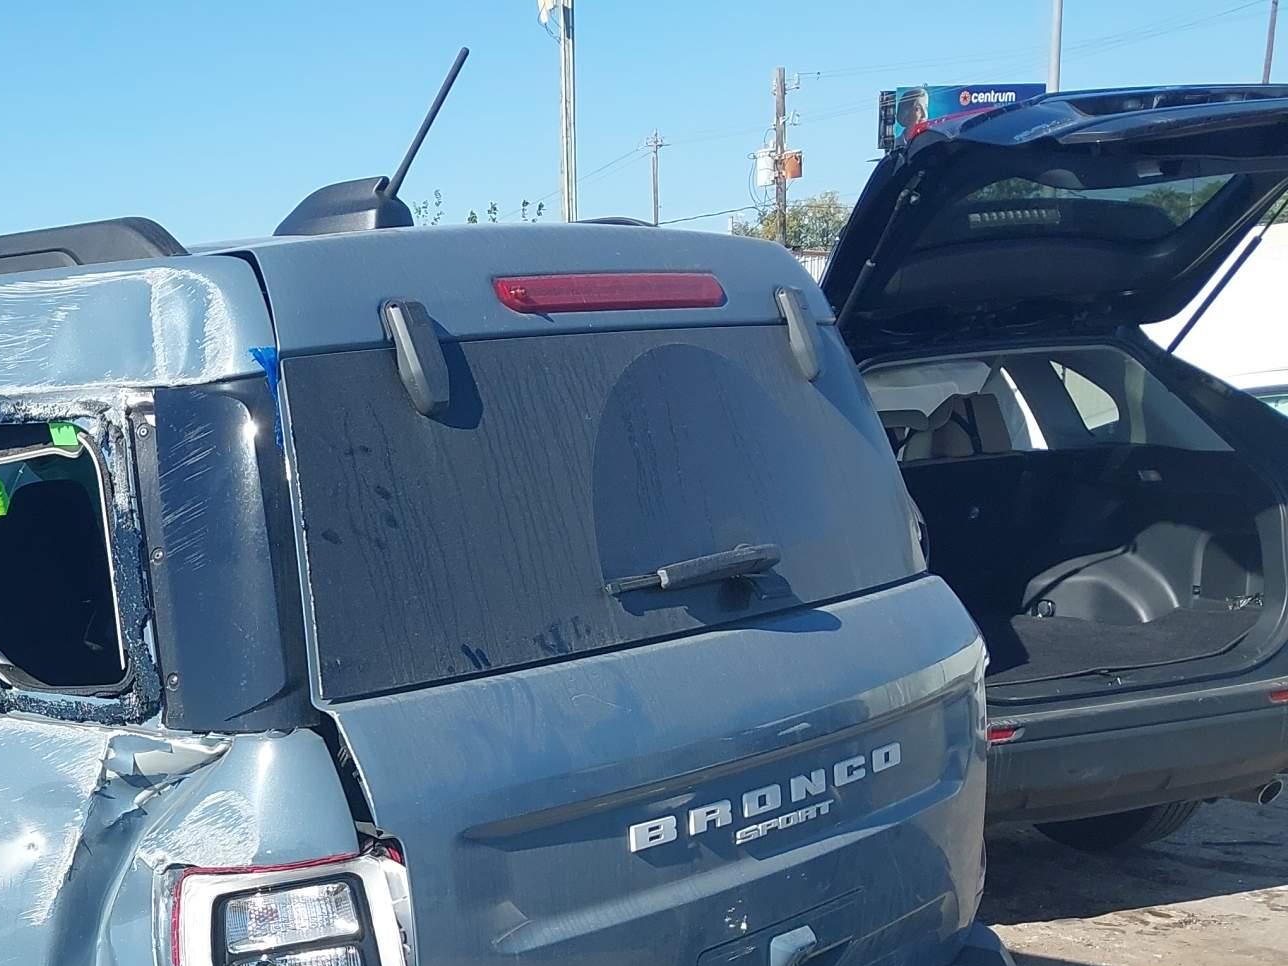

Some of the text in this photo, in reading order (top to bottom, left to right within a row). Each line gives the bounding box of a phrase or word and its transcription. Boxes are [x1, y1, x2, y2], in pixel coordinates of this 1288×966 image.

[972, 90, 1016, 103] centrum
[629, 743, 902, 852] BRONCO
[735, 799, 835, 845] SPORT
